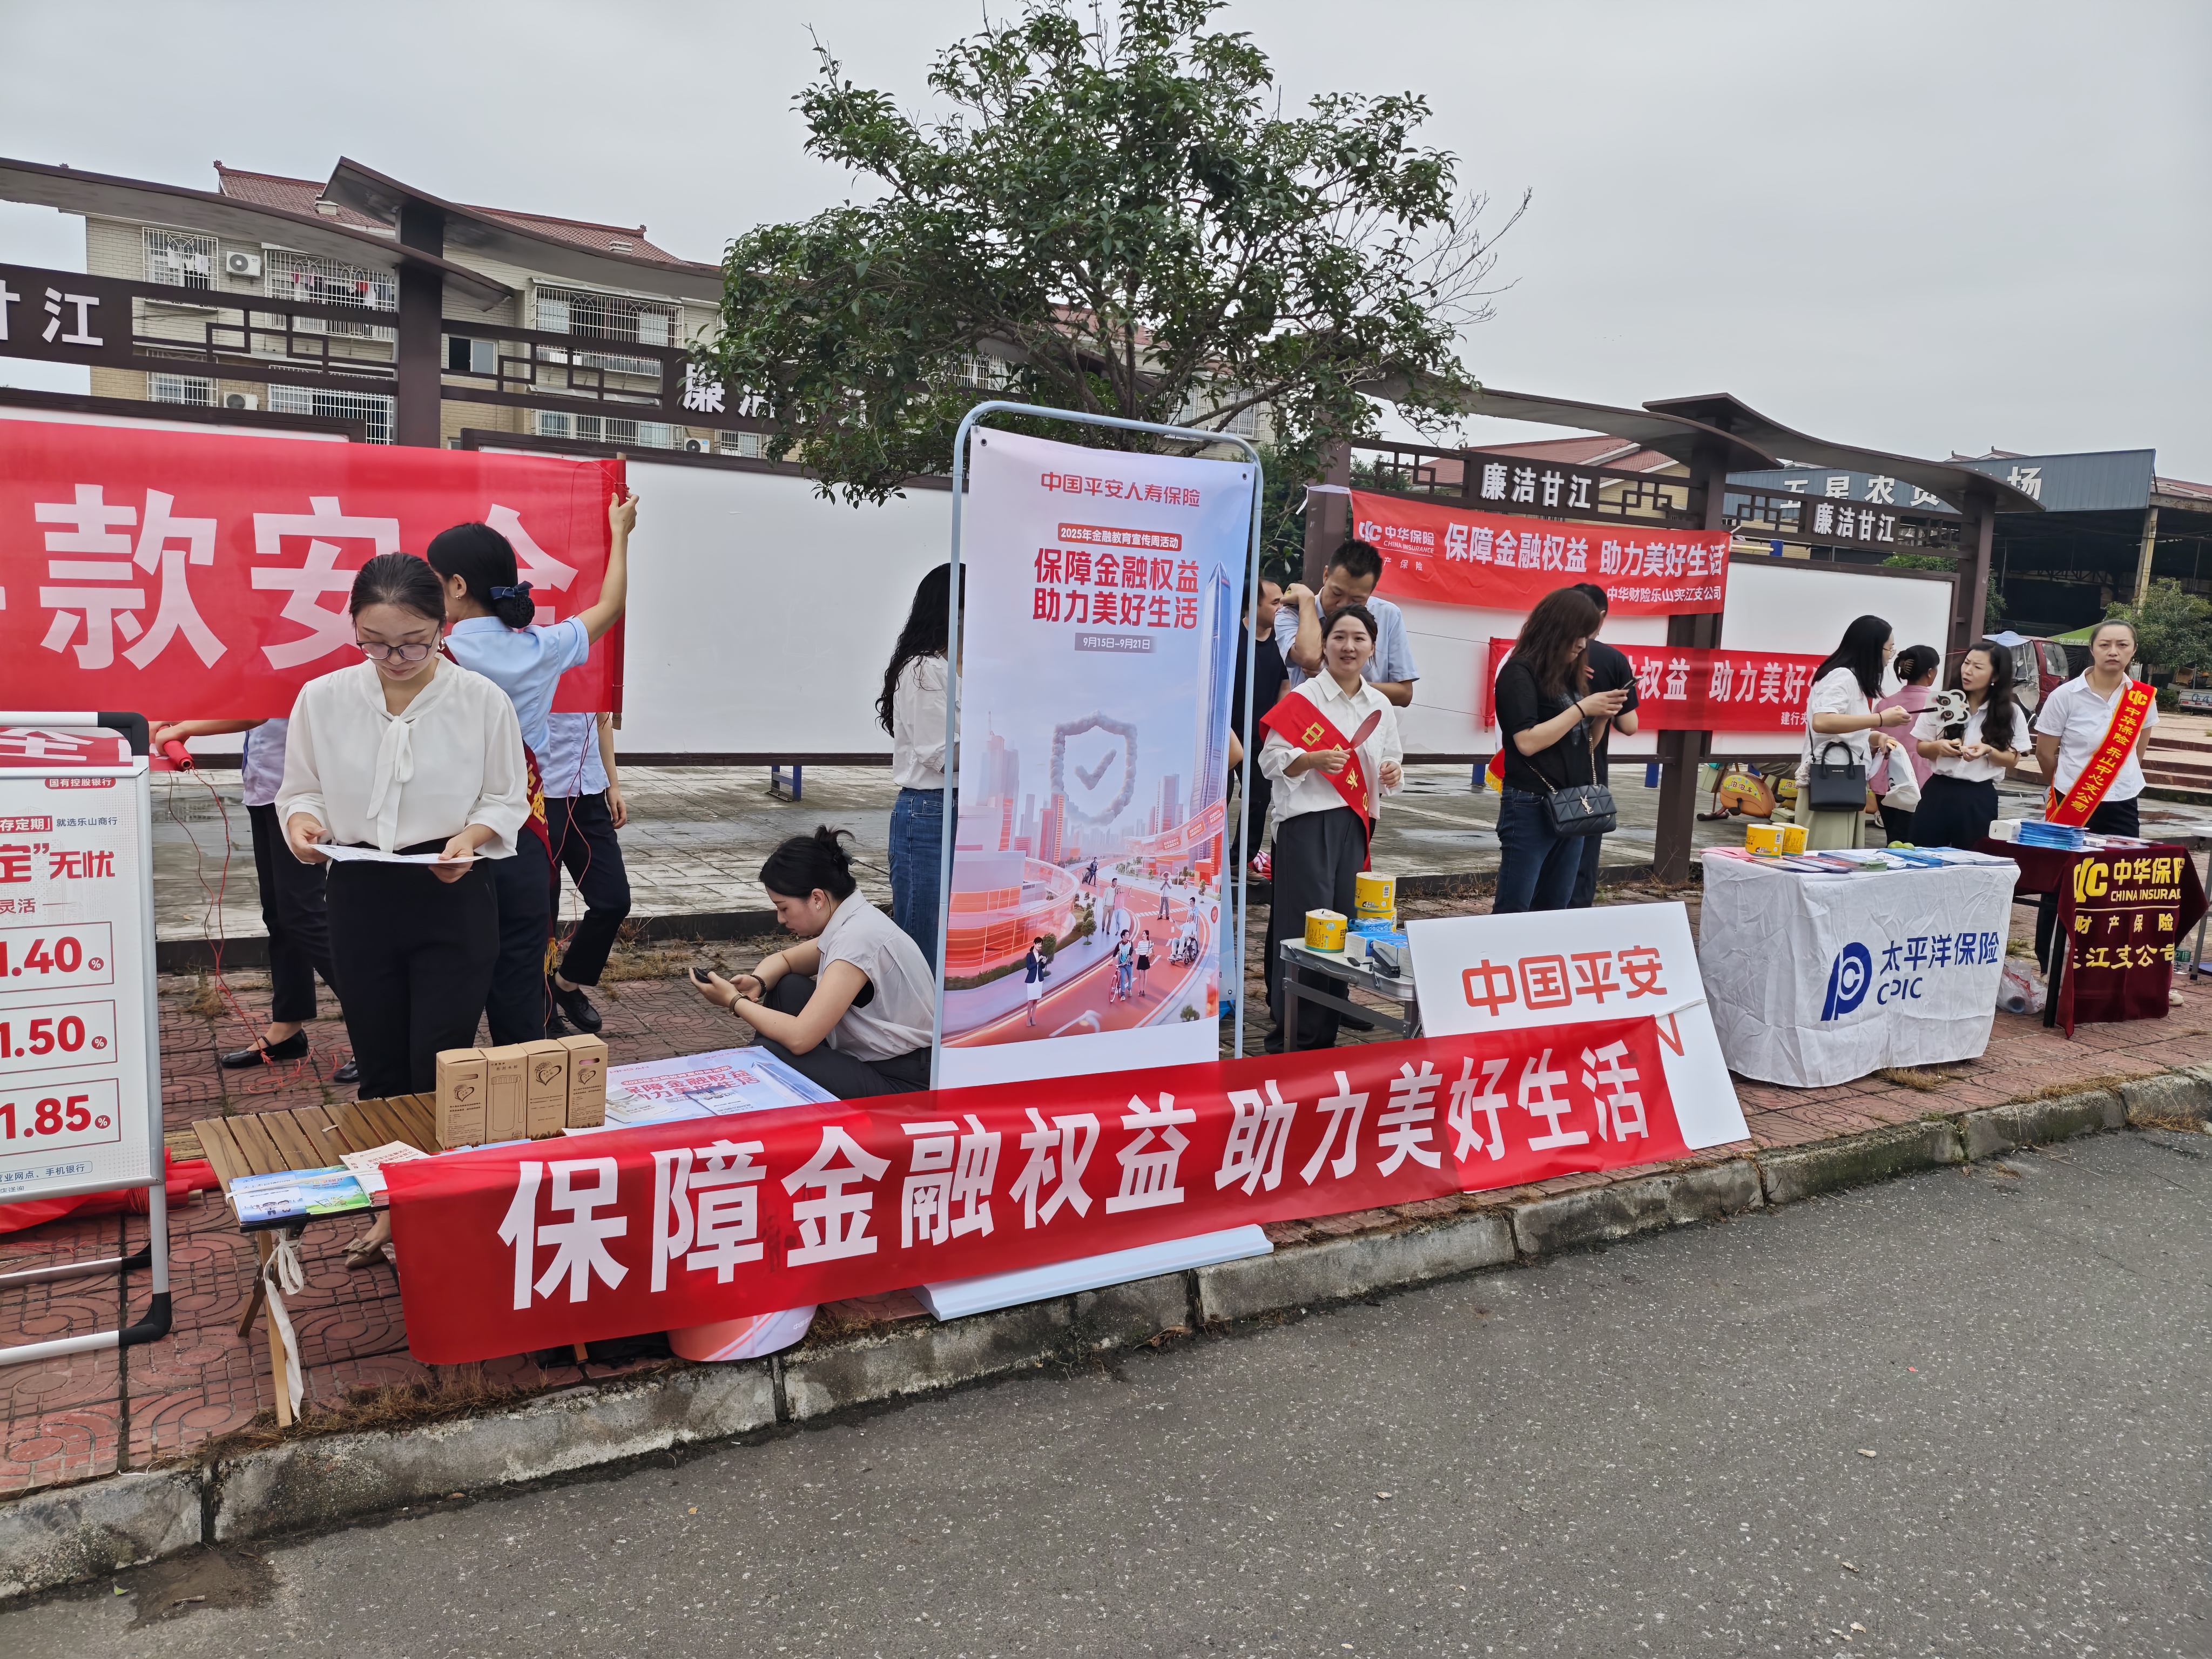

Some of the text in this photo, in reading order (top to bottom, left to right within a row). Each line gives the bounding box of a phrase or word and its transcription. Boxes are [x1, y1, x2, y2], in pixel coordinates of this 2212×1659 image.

[1041, 471, 1201, 507] 中国平安人寿保险
[1480, 463, 1592, 509] 廉洁甘江
[1061, 527, 1179, 549] 2025年金融教育宣传周活动
[1385, 525, 1435, 546] 中华保险
[1813, 502, 1896, 543] 廉洁甘江
[1383, 540, 1434, 554] CHINA INSURANCE
[1444, 522, 1727, 578] 保障金融权益 助力美好生活
[0, 480, 579, 670] 款安
[1034, 548, 1199, 594] 保障金融权益
[1033, 587, 1198, 630] 助力美好生活
[1606, 585, 1722, 604] 中华财险乐山夹江支公司
[1627, 655, 1813, 704] 权益 助力美好
[2070, 706, 2141, 813] 中华保险 乐山中心支公司
[49, 778, 112, 787] 国有控股银行
[1730, 780, 1753, 793] 泡泡车
[56, 817, 118, 827] 就选乐山商行
[0, 898, 37, 915] 灵活
[2110, 890, 2137, 902] CHINA
[1879, 932, 1999, 976] 太平洋保险
[1461, 945, 1668, 1017] 中国平安
[0, 1163, 85, 1183] 业网点、手机银行
[497, 1039, 1651, 1311] 保障金融权益 助力美好生活
